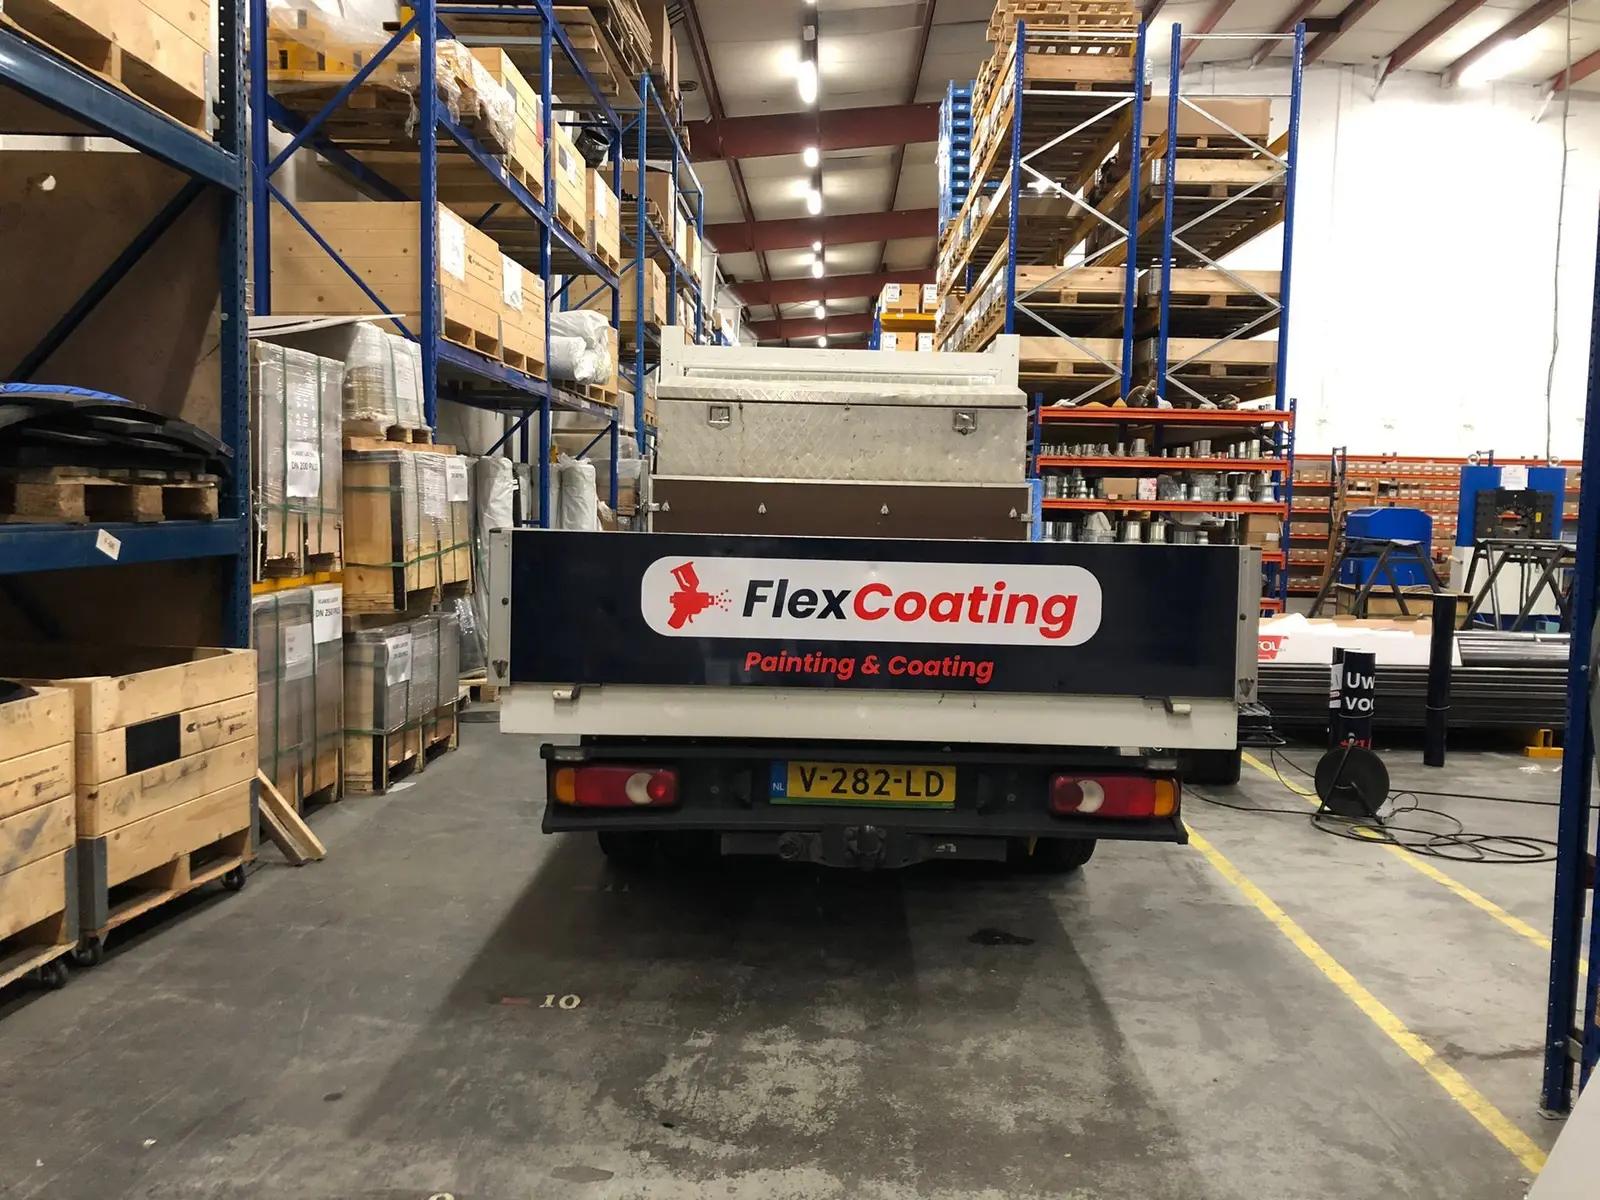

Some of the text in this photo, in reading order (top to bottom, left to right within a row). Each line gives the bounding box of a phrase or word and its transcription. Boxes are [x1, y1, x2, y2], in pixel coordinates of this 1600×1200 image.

[742, 578, 1078, 640] FlexCoating
[744, 650, 995, 684] Painting & Coating
[1347, 671, 1375, 690] Uw
[772, 783, 785, 792] NL
[799, 765, 945, 798] V-282-LD
[539, 993, 582, 1010] 10
